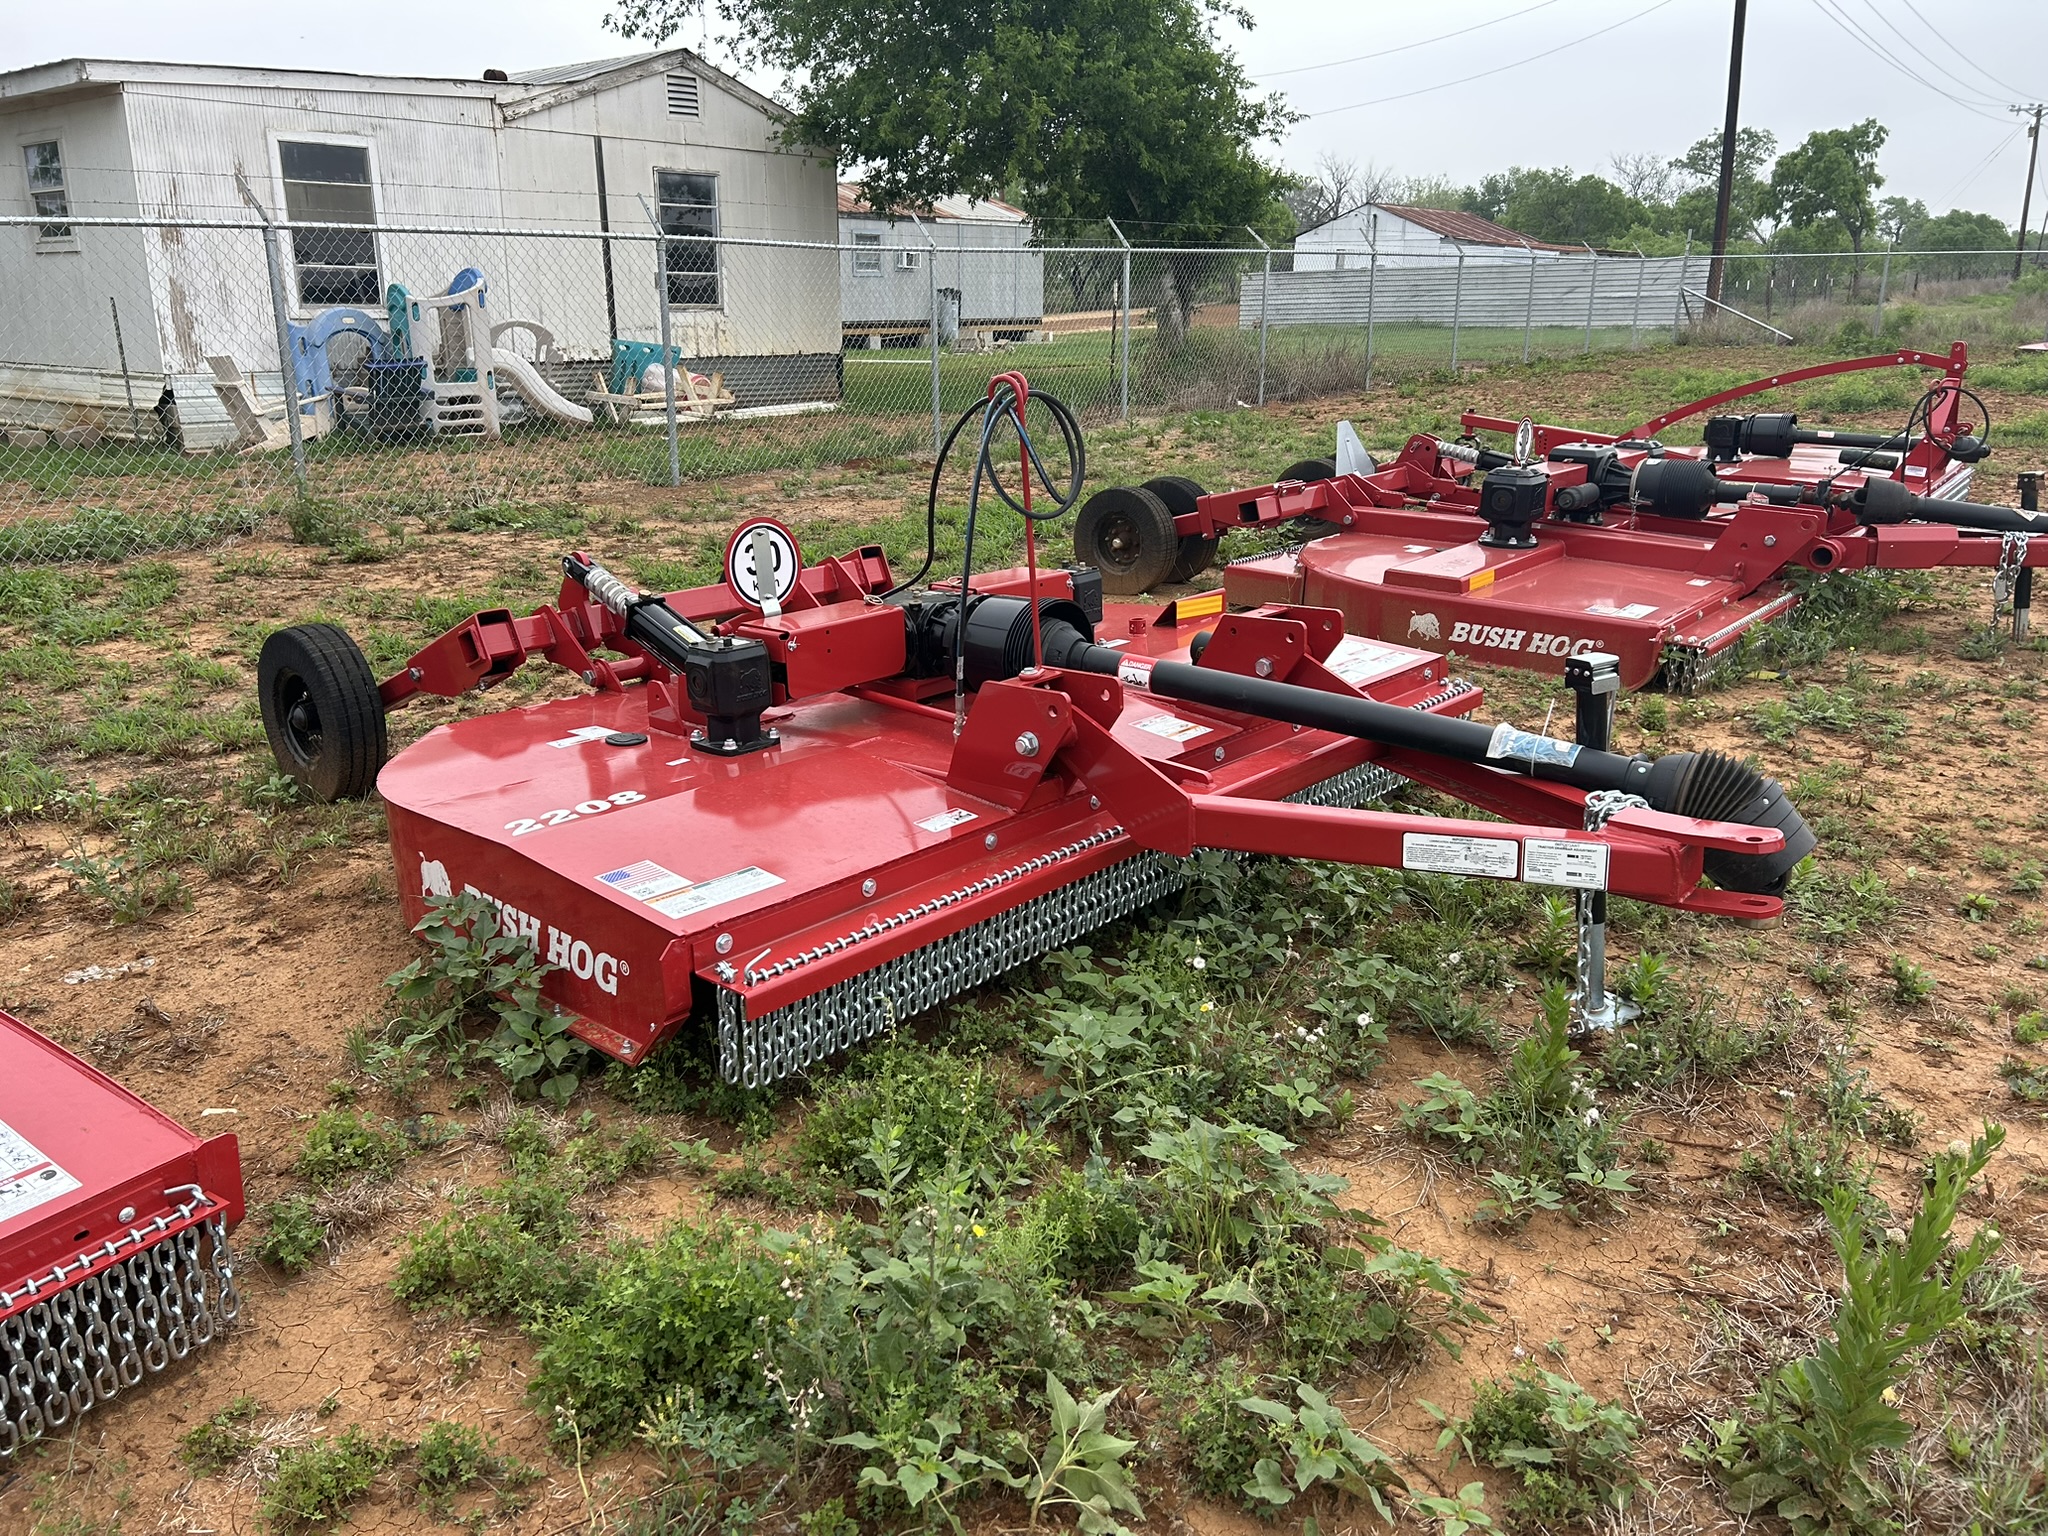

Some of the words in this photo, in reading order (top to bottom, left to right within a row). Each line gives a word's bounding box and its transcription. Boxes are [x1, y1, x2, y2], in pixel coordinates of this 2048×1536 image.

[1448, 622, 1526, 650] BUSH
[1129, 660, 1153, 671] DANGER
[504, 790, 647, 837] 2208
